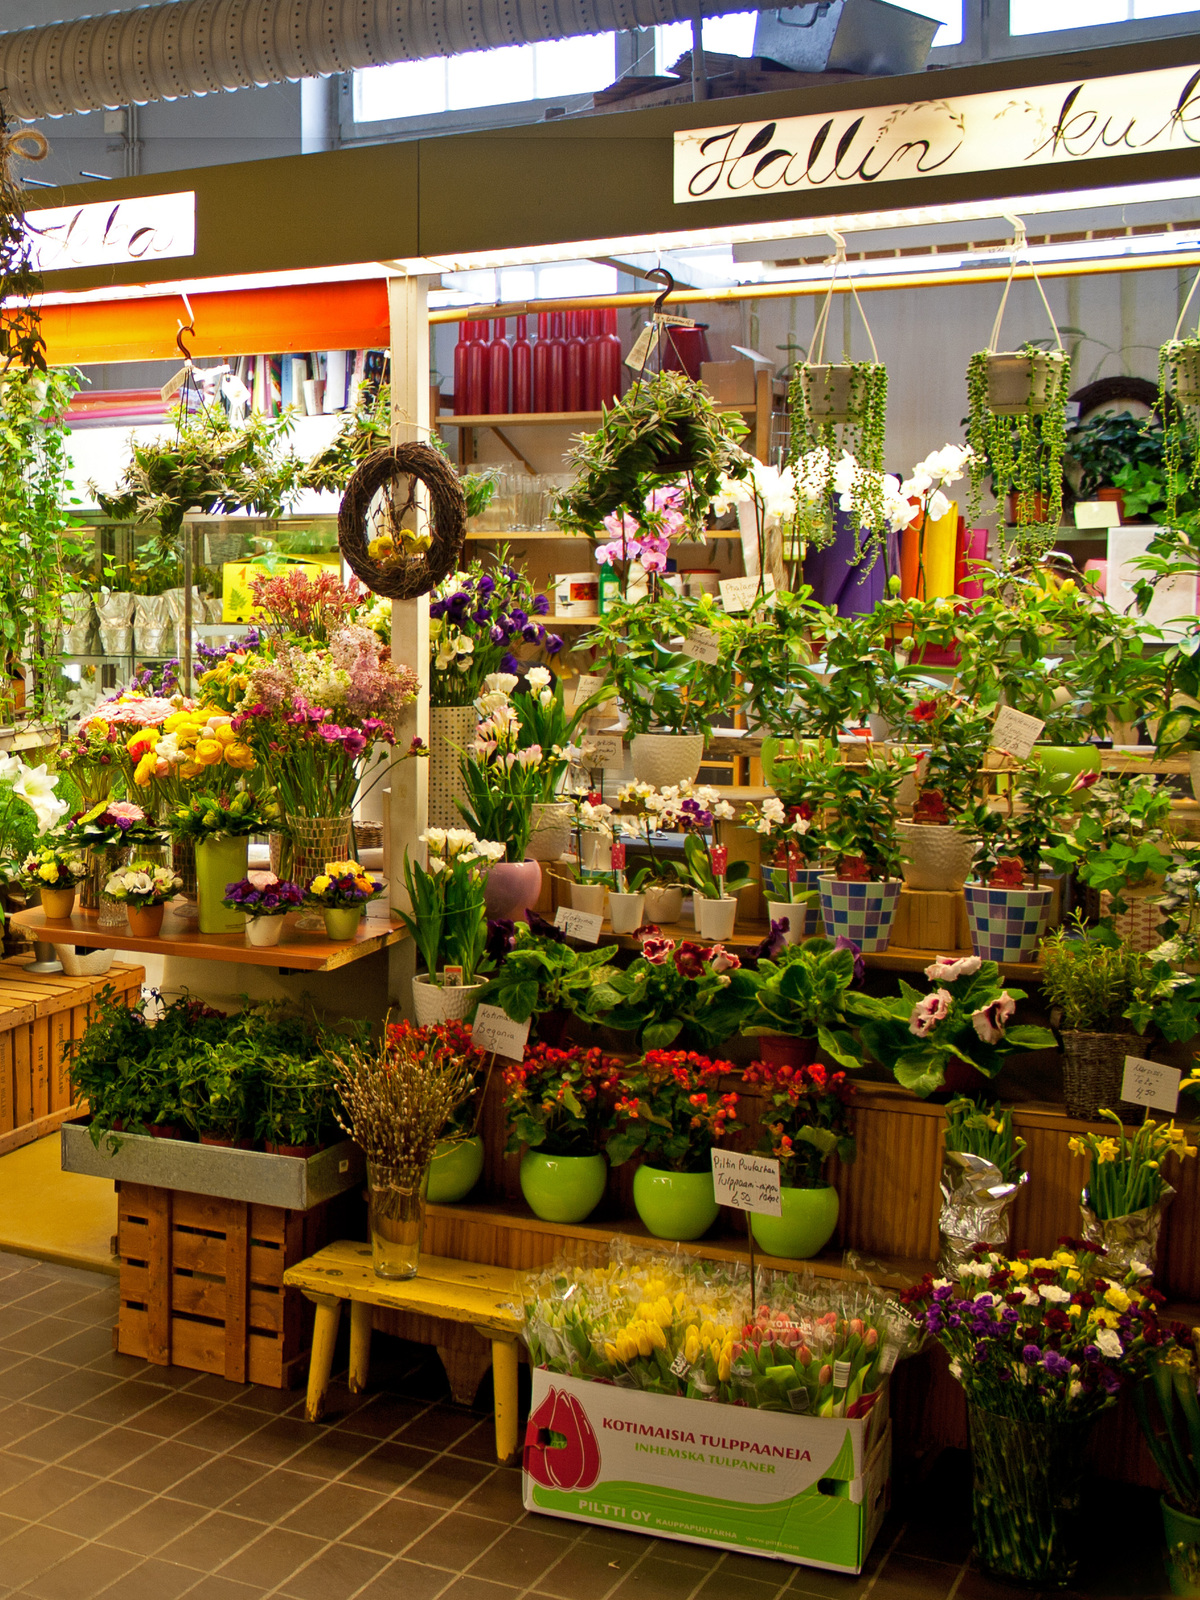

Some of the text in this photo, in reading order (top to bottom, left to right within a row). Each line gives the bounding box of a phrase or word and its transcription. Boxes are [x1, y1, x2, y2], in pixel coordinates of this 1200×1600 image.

[688, 116, 964, 197] Hallin
[475, 1021, 515, 1039] Begonia
[602, 1416, 812, 1462] KOTIMAISIA TULPPAANEJA
[635, 1441, 777, 1475] INHEMSKA TULPANER
[578, 1498, 627, 1520] PILTTI
[631, 1503, 652, 1523] OY
[655, 1516, 738, 1540] KAUPPAPUUTARHA
